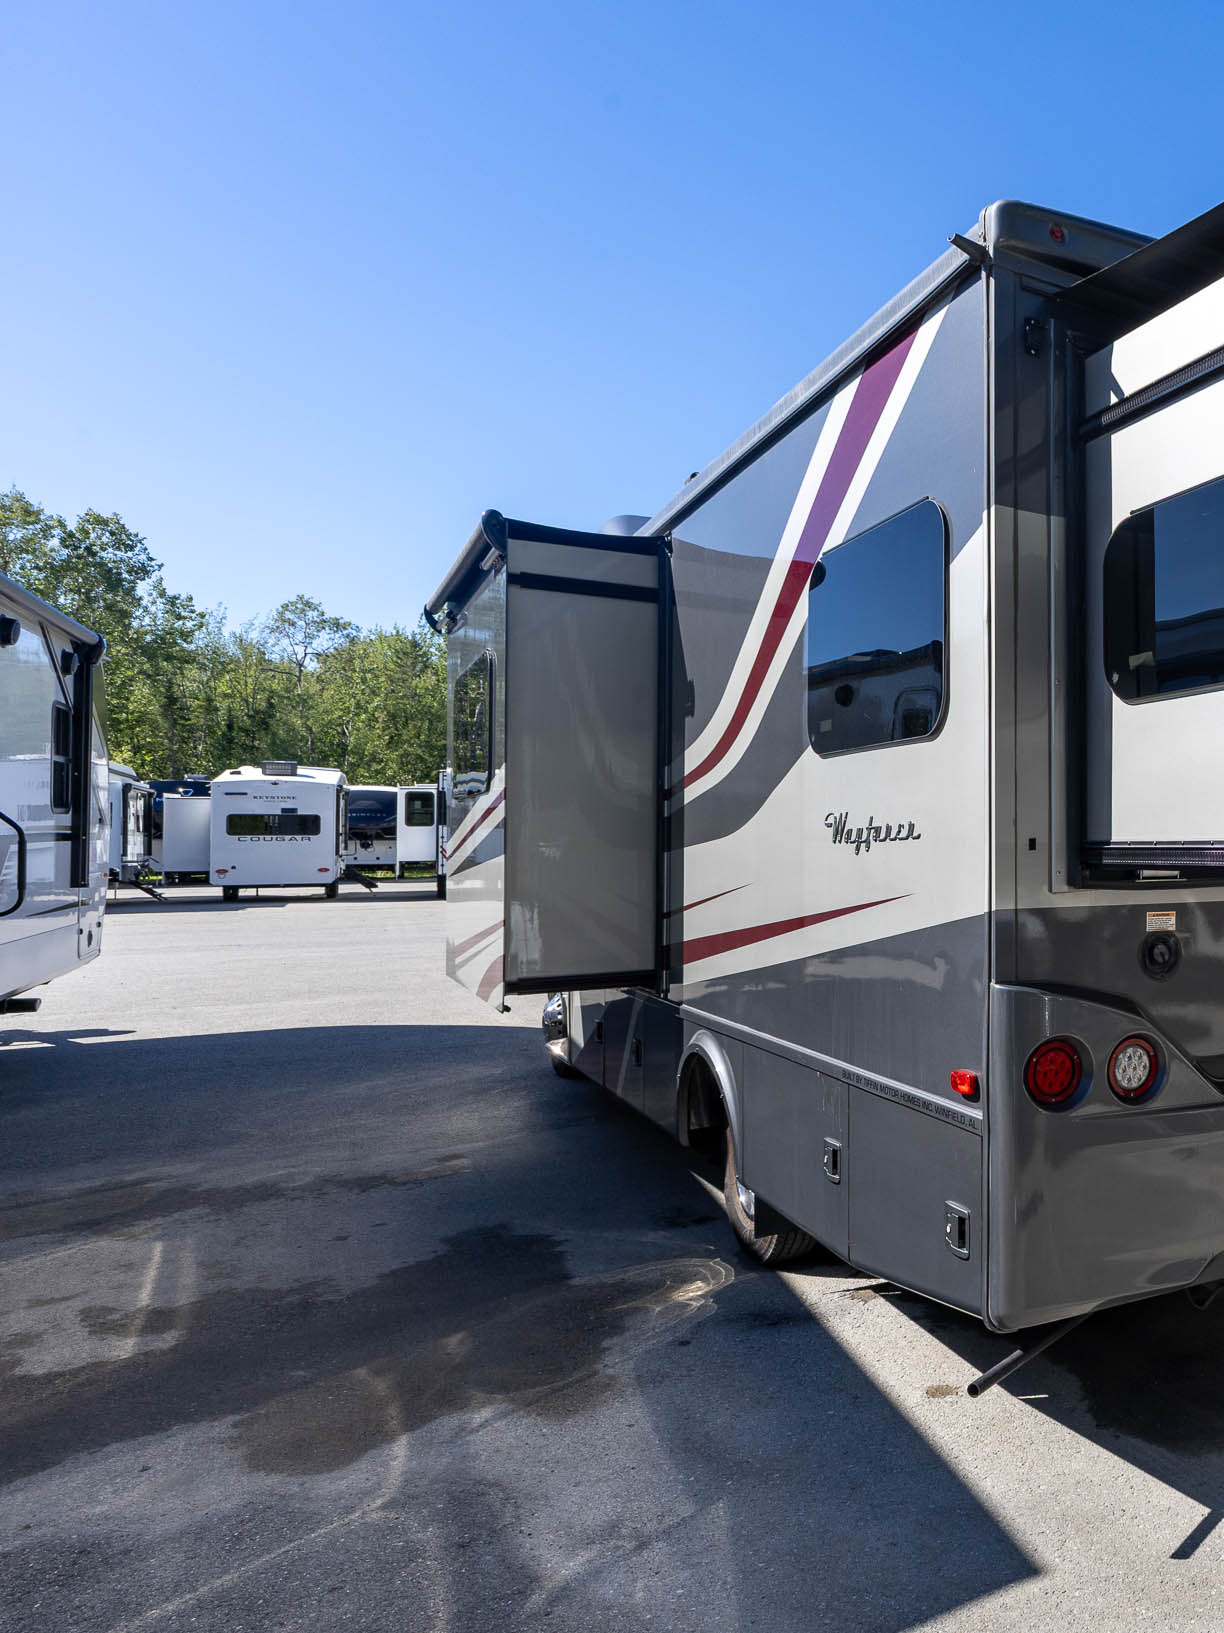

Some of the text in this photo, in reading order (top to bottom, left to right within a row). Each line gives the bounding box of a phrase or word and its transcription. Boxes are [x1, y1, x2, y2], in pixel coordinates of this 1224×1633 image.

[824, 811, 922, 856] Wayfarer
[863, 1077, 879, 1091] TIFFIN
[880, 1084, 900, 1098] MOTOR
[900, 1091, 921, 1108] HOMES
